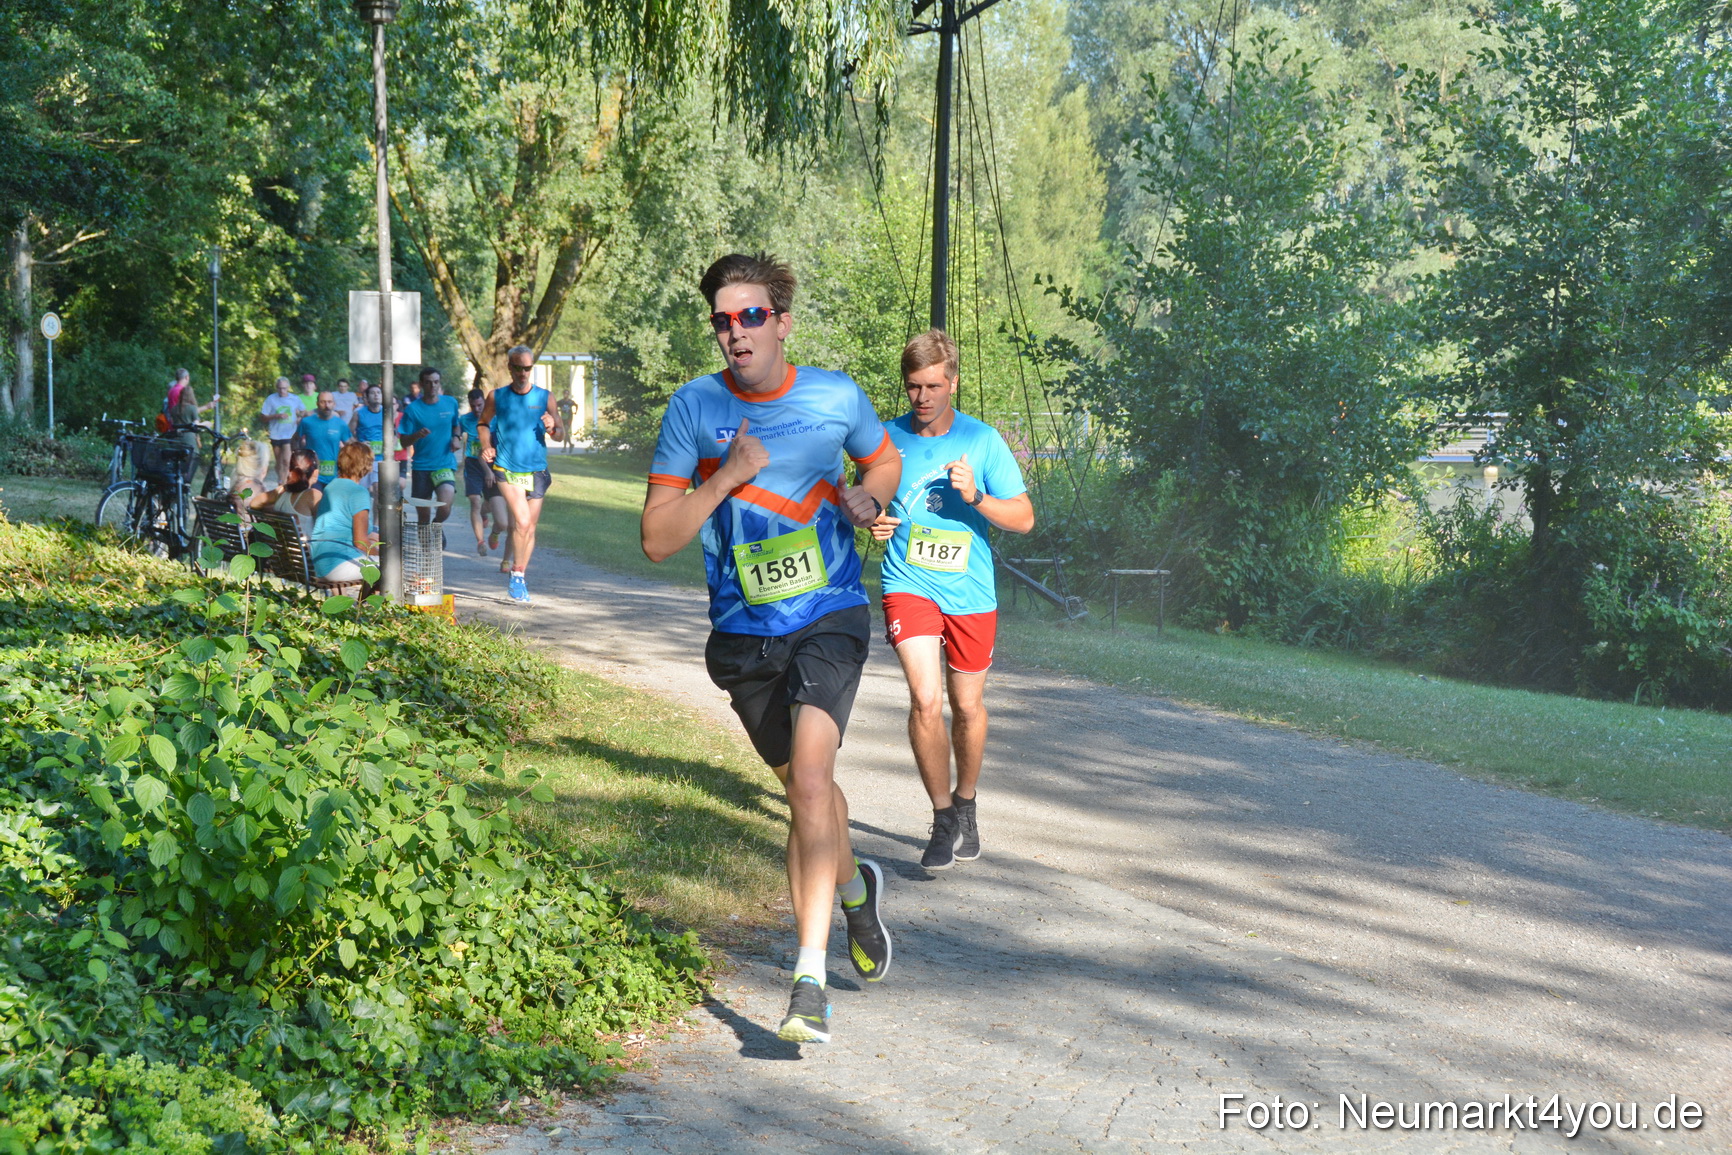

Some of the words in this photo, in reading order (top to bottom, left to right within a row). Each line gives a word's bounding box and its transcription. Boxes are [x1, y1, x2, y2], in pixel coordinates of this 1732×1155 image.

[816, 423, 826, 432] eG
[911, 469, 938, 490] Schick
[916, 540, 962, 560] 1187
[750, 551, 811, 586] 1581
[758, 581, 789, 593] Eberwein
[789, 574, 813, 586] Bastian
